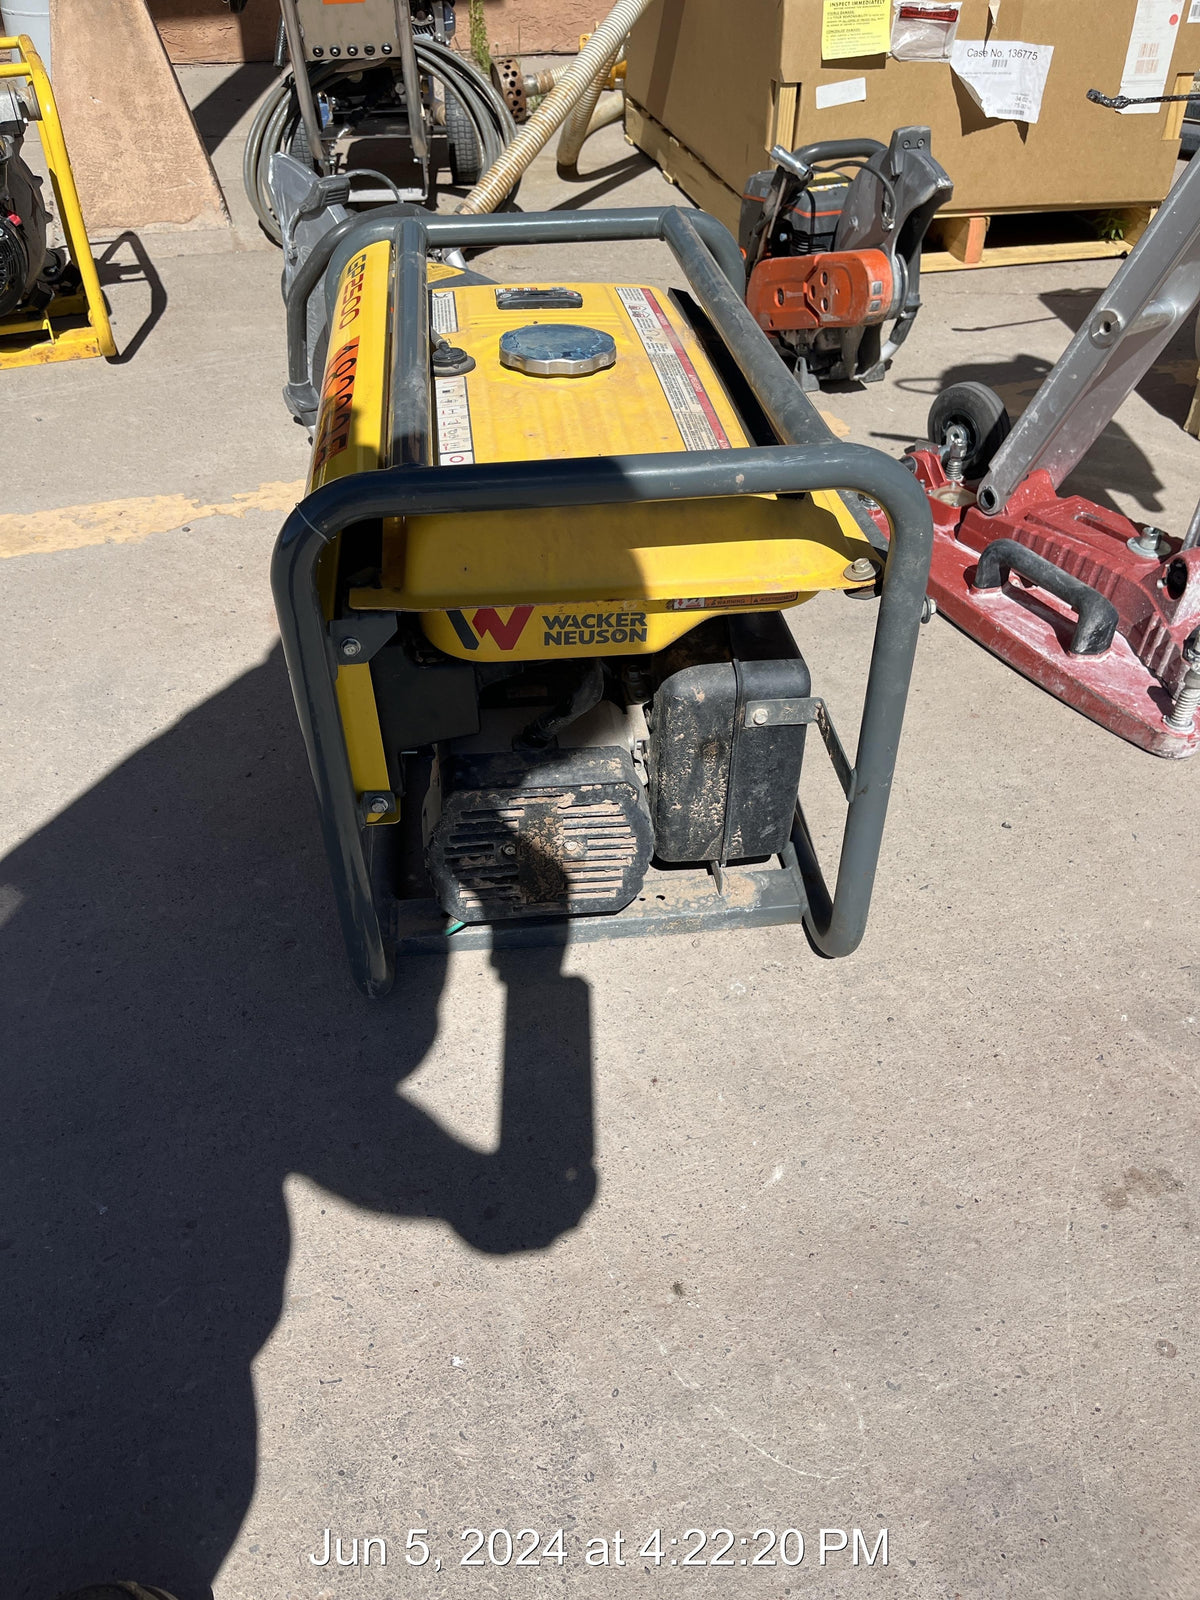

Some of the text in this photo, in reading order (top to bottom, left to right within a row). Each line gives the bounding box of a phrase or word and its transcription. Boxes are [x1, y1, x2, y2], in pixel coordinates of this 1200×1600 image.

[967, 48, 1039, 61] Case No. 136775
[339, 254, 367, 330] GP2500
[542, 612, 648, 630] WACKER
[544, 628, 647, 646] NEUSON
